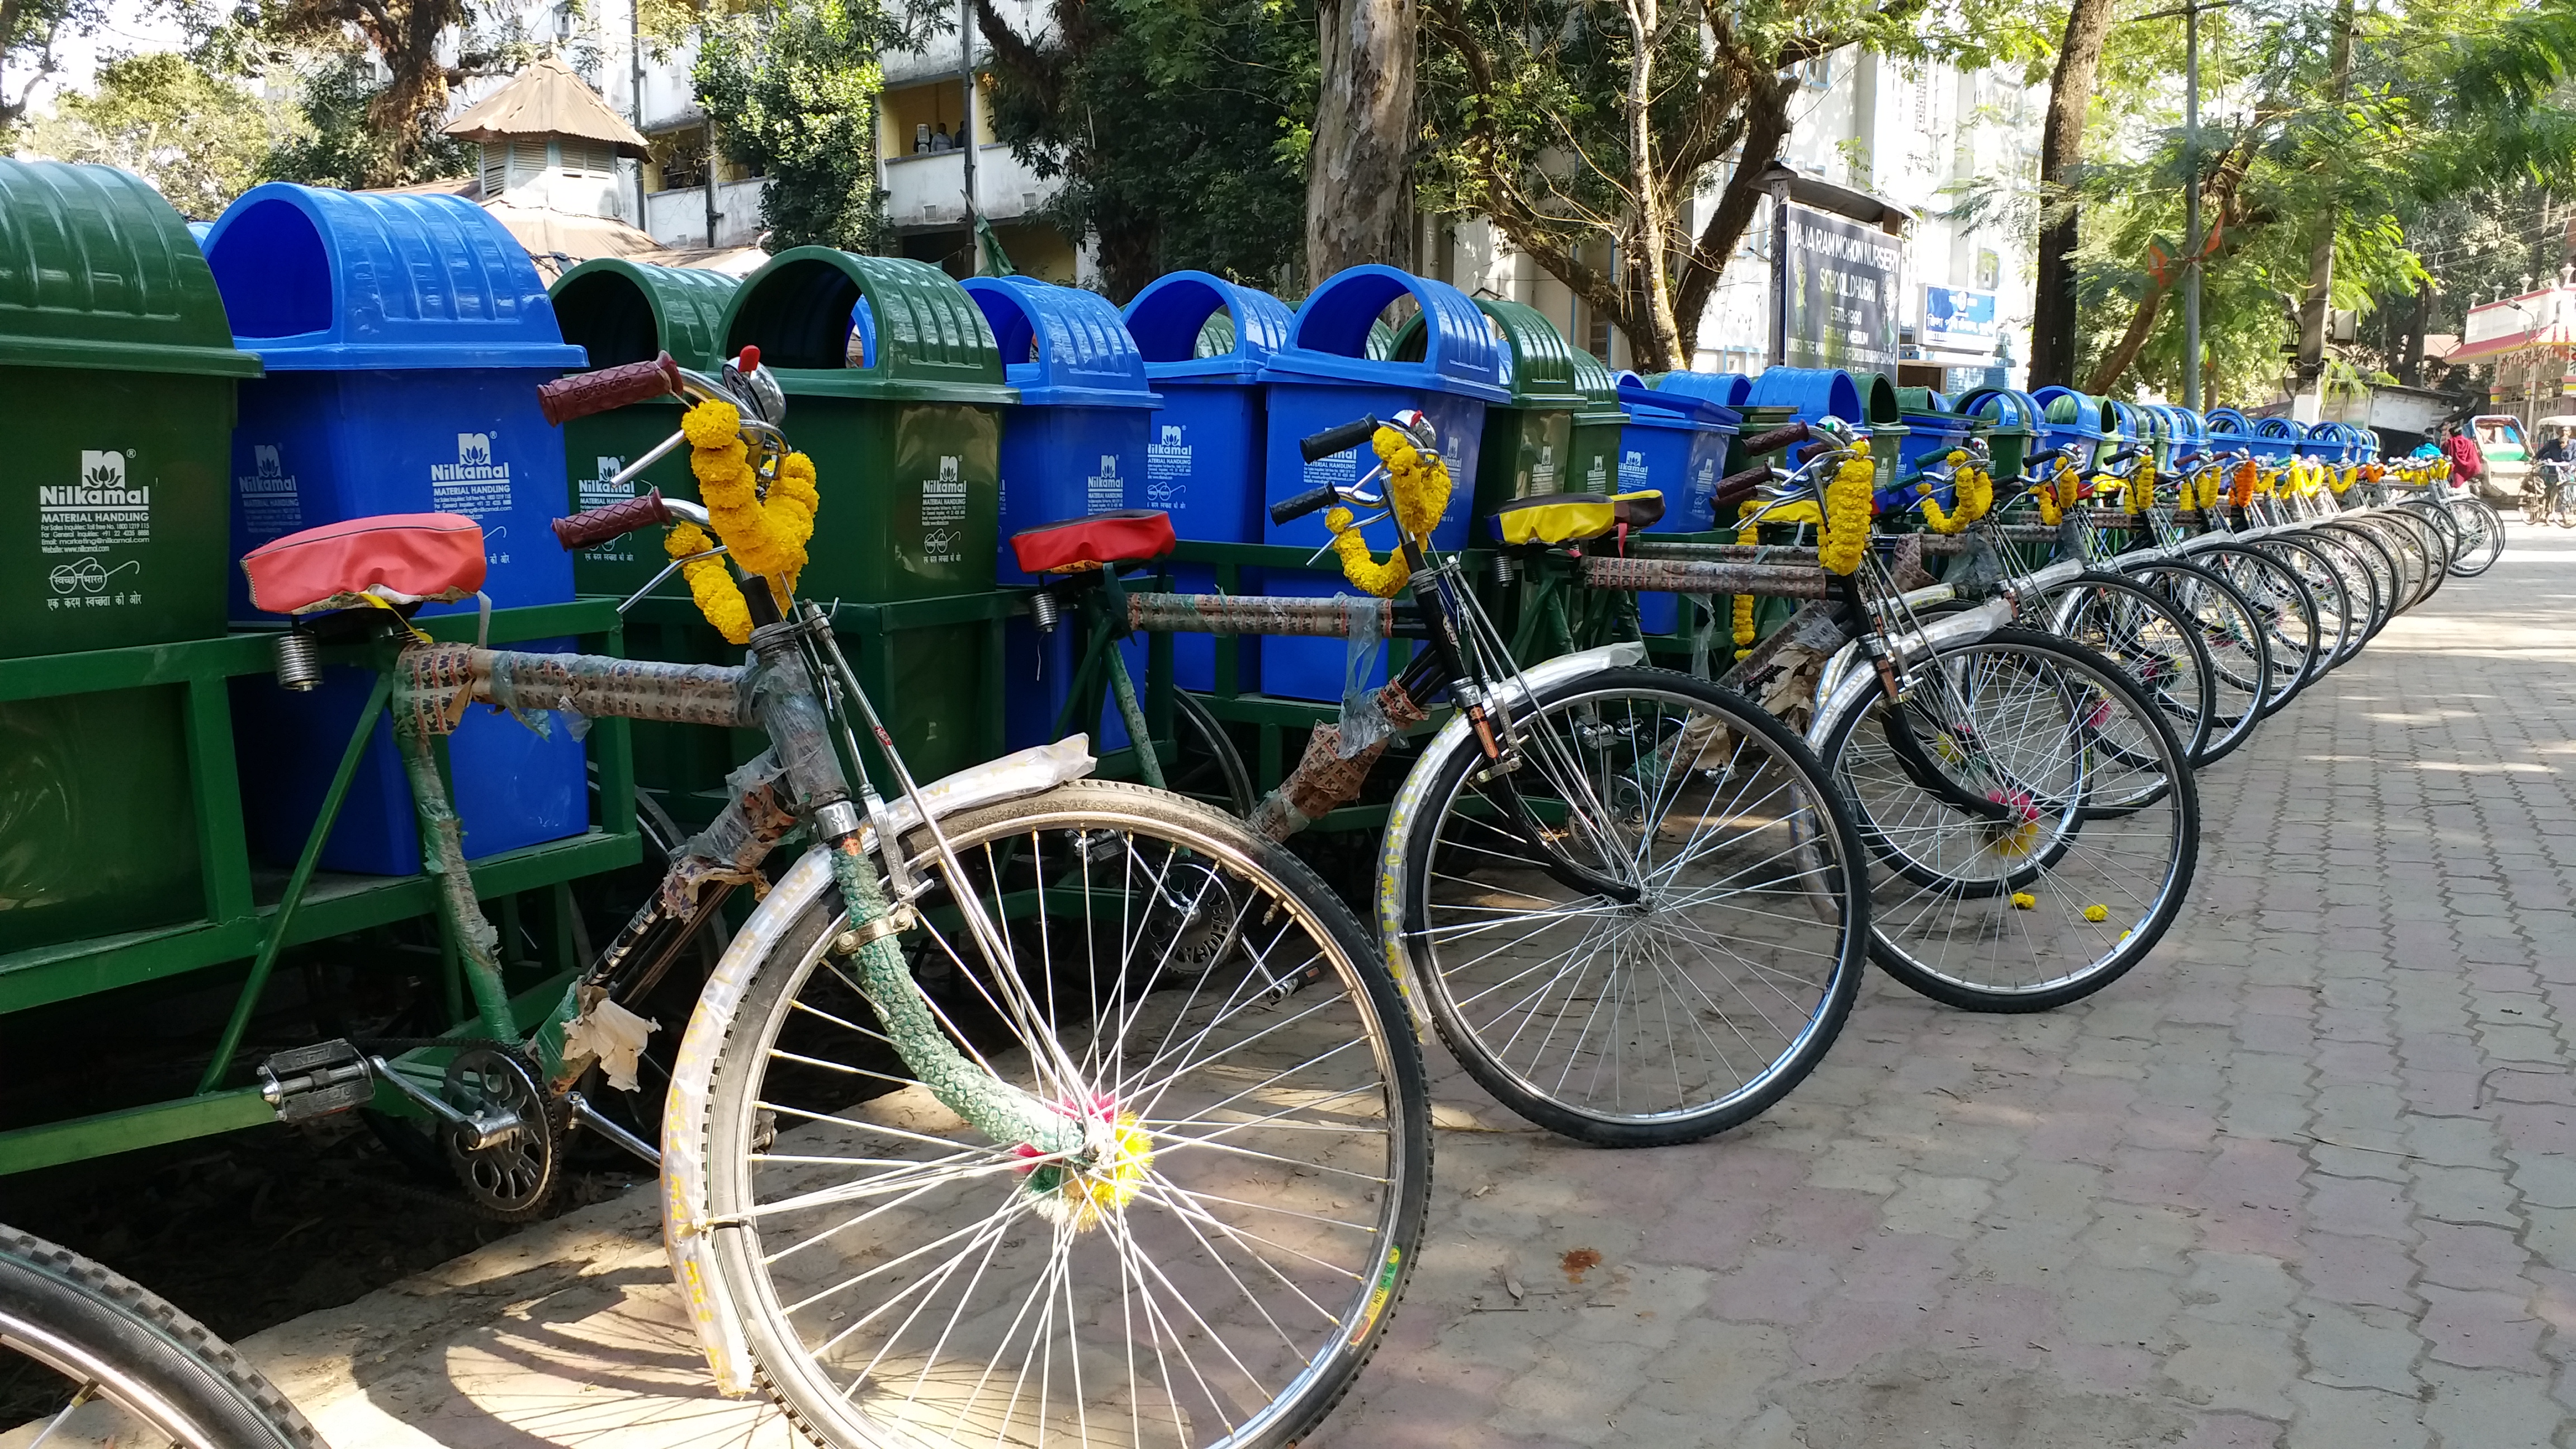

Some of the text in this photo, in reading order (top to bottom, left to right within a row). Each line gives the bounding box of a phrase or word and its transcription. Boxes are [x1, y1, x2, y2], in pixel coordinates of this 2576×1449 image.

[1790, 220, 1901, 273] RAJA RAM MOHON NURSERY
[431, 462, 510, 481] Nilkamal
[1618, 462, 1648, 473] ilkamal
[239, 475, 297, 493] Nilkamal
[434, 485, 510, 496] MATERIAL HANDLING
[923, 480, 967, 493] Nilkamal
[1088, 476, 1123, 488] Nilkamal
[40, 486, 149, 505] Nilkamal
[41, 512, 149, 523] MATERIAL HANDLING
[54, 575, 103, 585] स्वच्छ भारत
[46, 590, 142, 611] एक कदम स्वच्छता की ओर
[421, 652, 434, 689] K.W.
[439, 652, 453, 688] K.W.
[423, 695, 439, 733] K.W.
